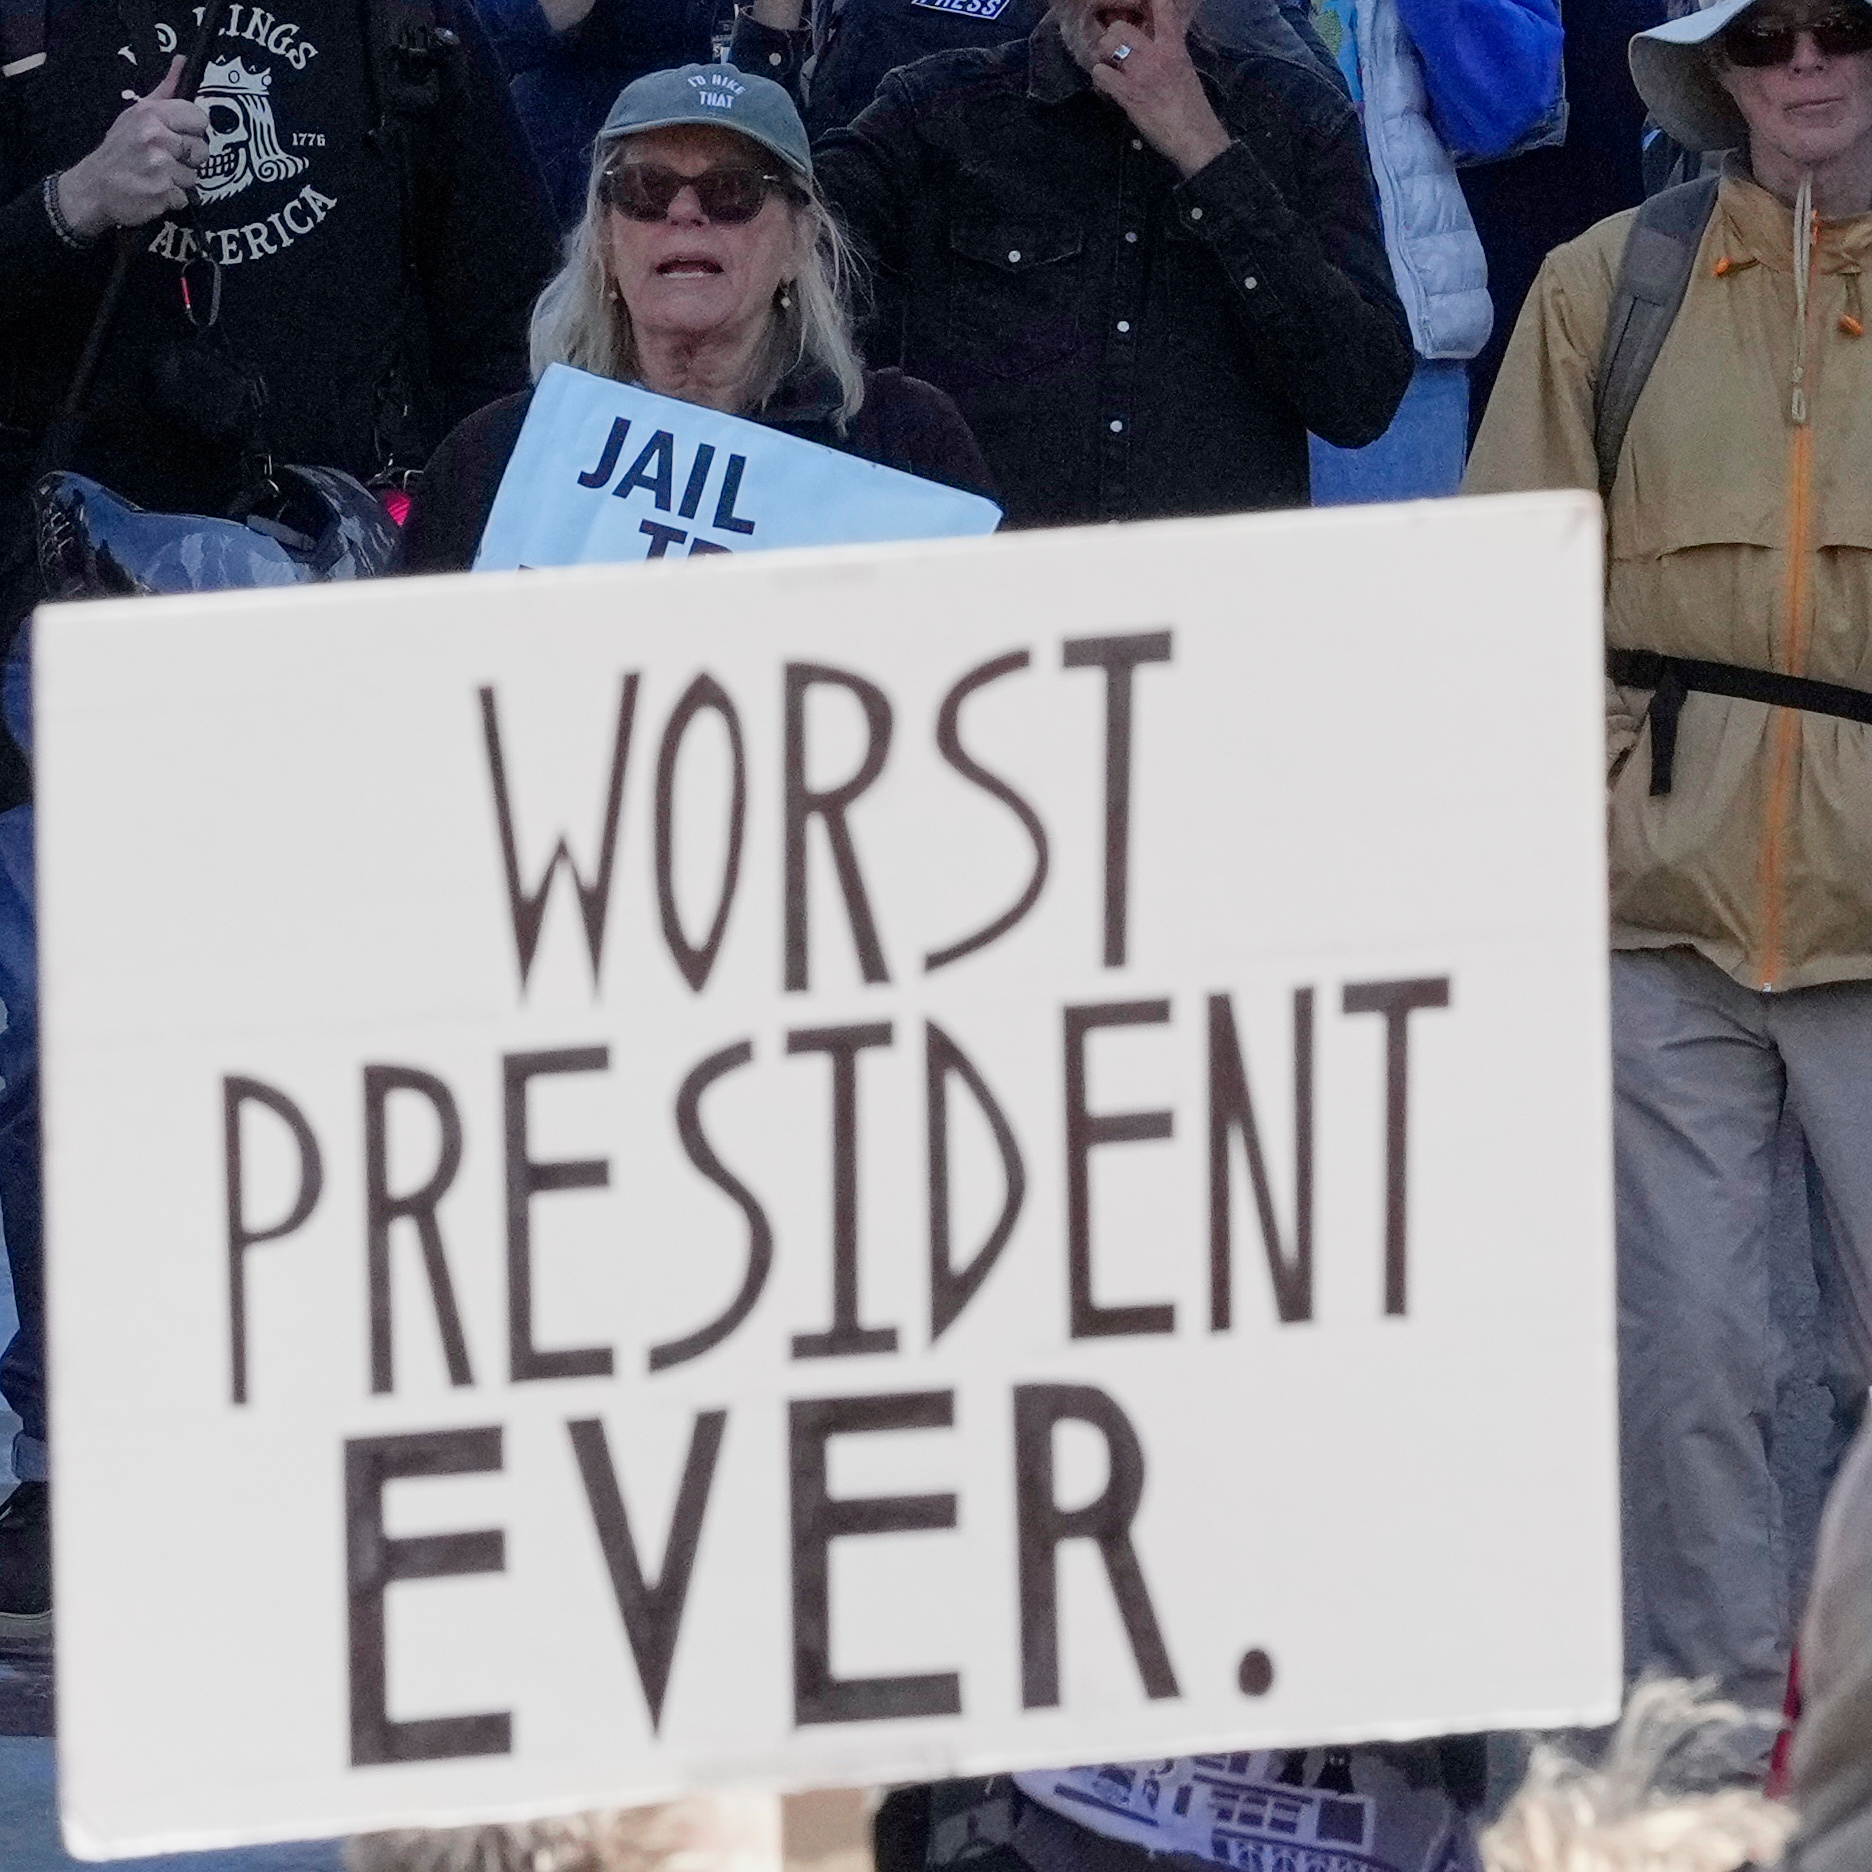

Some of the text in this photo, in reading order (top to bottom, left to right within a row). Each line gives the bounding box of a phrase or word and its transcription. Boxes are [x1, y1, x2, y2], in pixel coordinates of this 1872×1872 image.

[292, 132, 327, 148] 1776
[700, 92, 735, 110] THAT
[713, 75, 747, 95] HIKE
[577, 415, 756, 537] JAIL
[477, 628, 1176, 998] WORST
[220, 973, 1453, 1407] PRESIDENT
[340, 1378, 1278, 1768] EVER.
